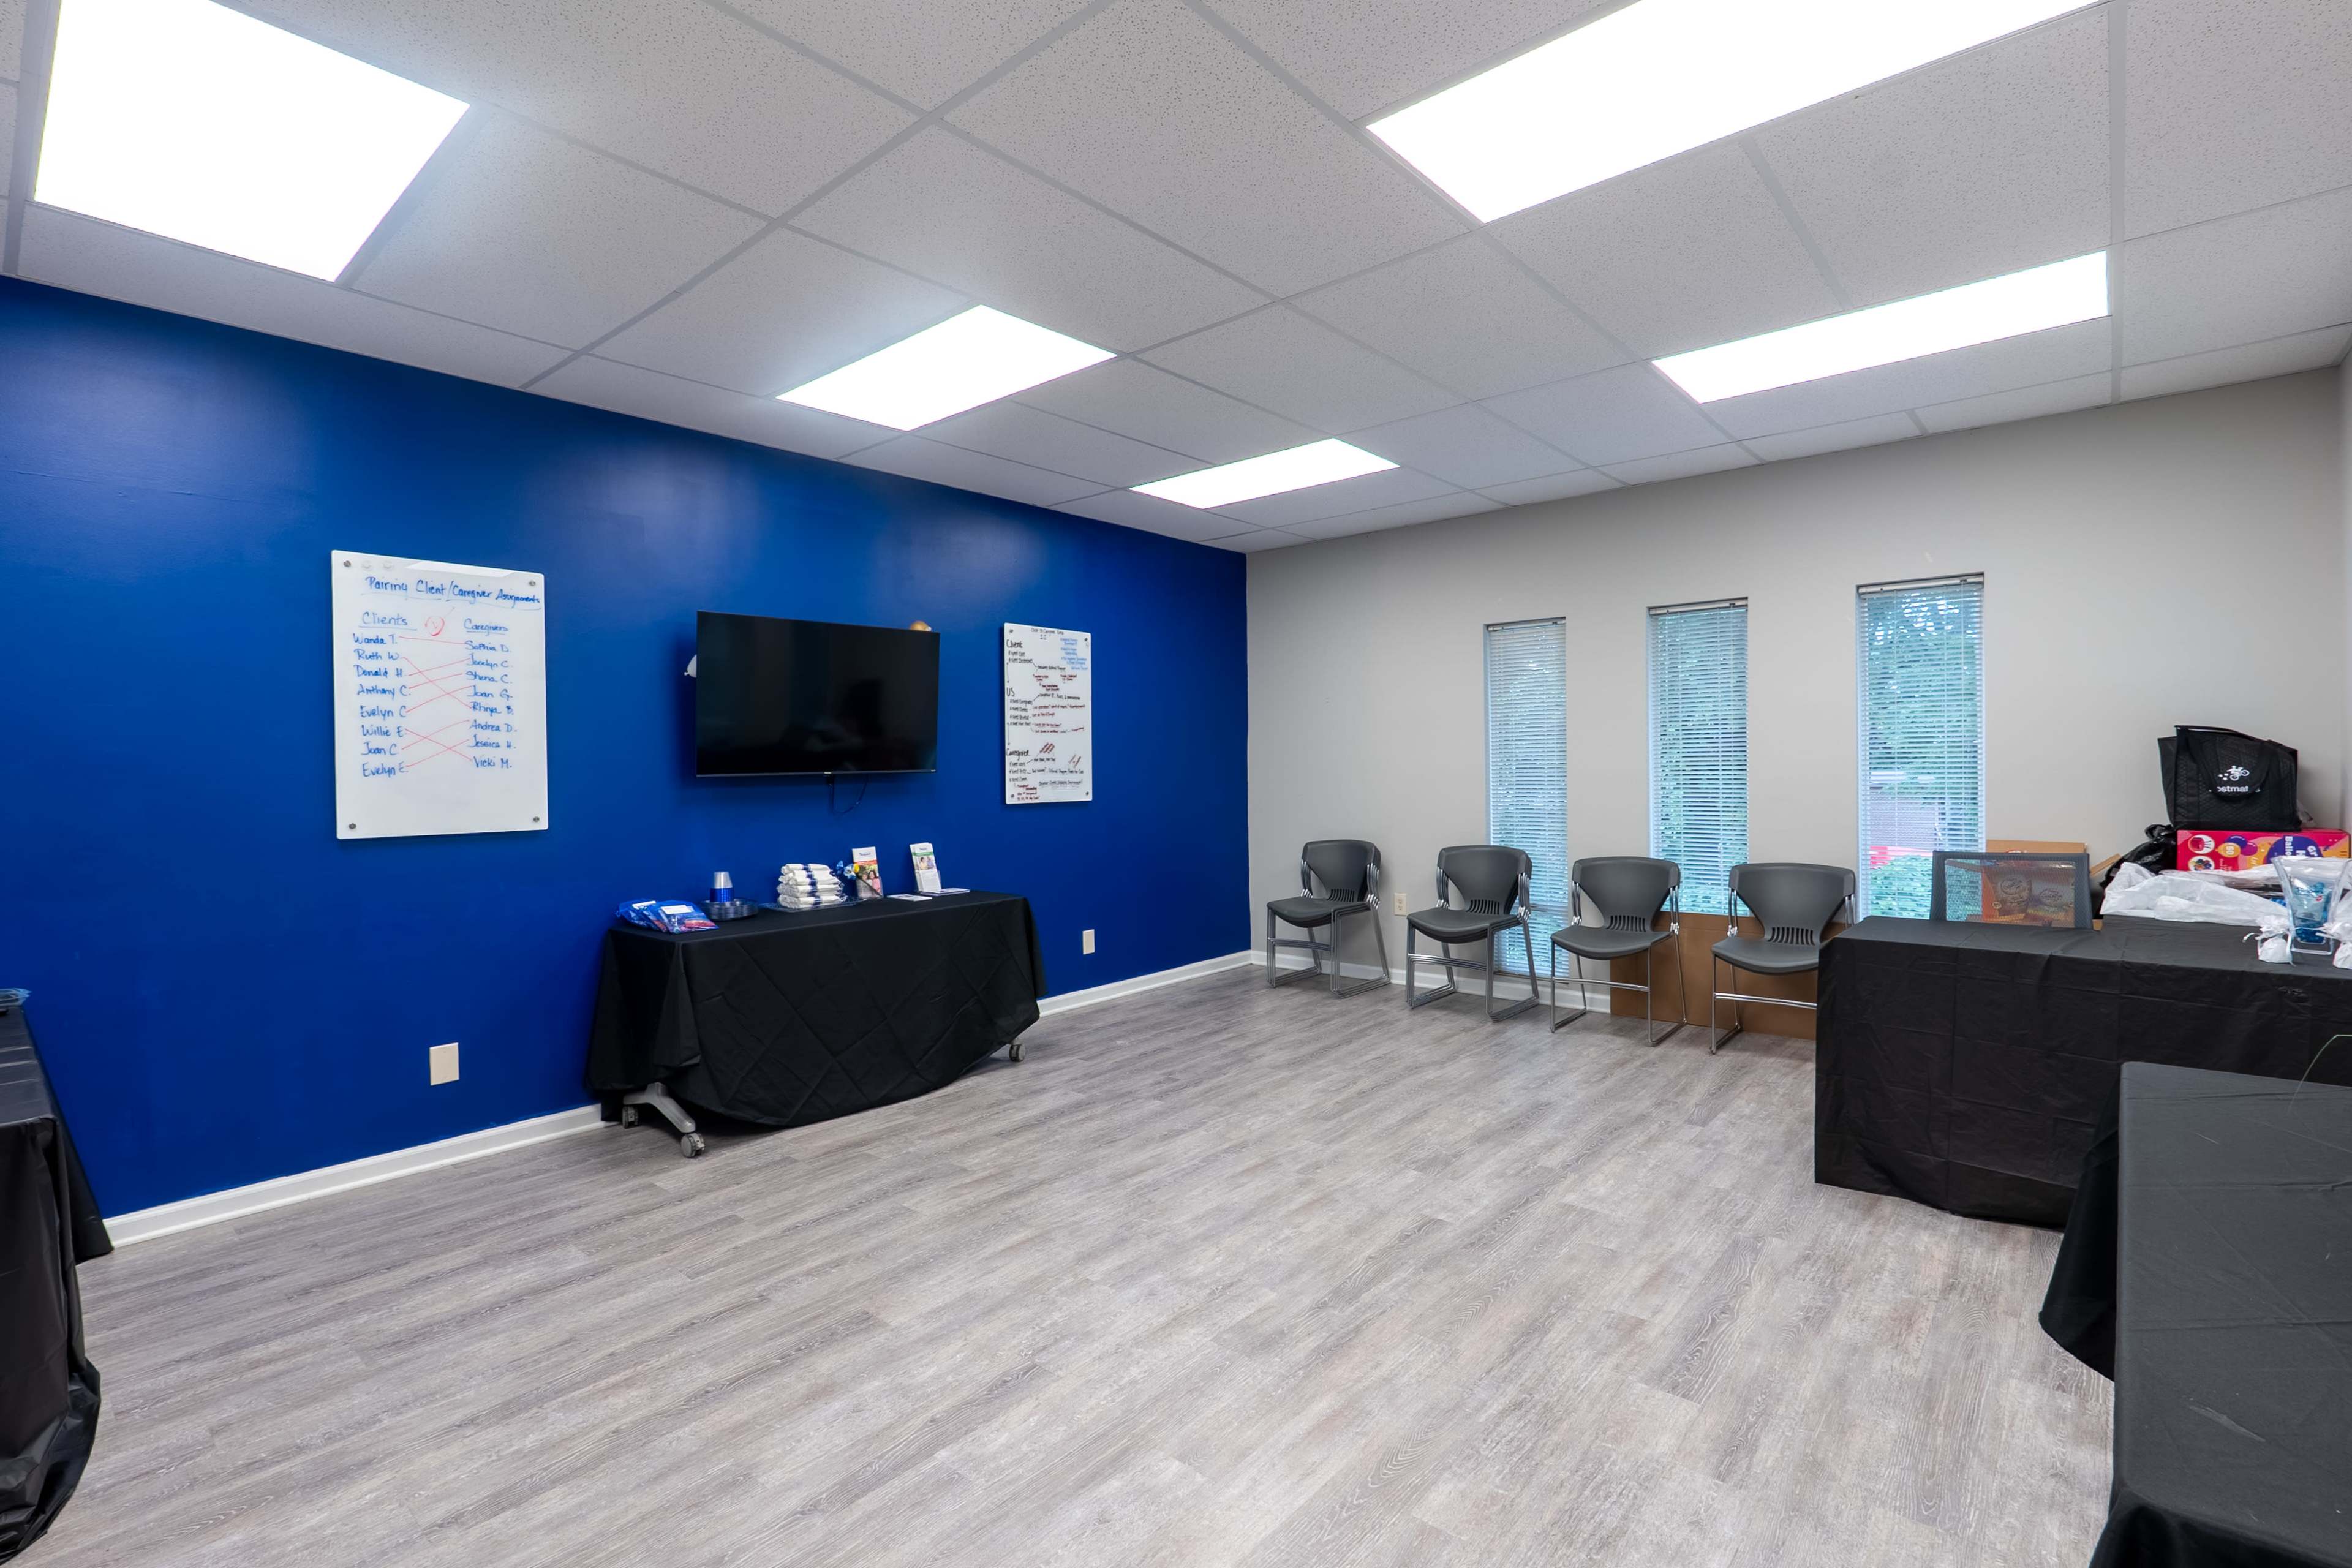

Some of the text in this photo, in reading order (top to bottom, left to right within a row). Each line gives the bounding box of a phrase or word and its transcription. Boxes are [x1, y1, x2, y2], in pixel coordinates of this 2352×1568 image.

[361, 611, 409, 626] Clients
[464, 617, 508, 636] Caregivers
[352, 633, 387, 644] Wanda
[353, 648, 383, 660] Ruth
[353, 664, 388, 678] Donald
[356, 683, 396, 700] Anthony
[1006, 687, 1015, 697] US
[360, 705, 394, 721] Evelyn
[361, 725, 391, 737] Willie
[469, 718, 502, 732] Andrea
[467, 734, 500, 748] Jessica
[362, 763, 396, 778] Evelyn
[2285, 835, 2293, 856] Ballo
